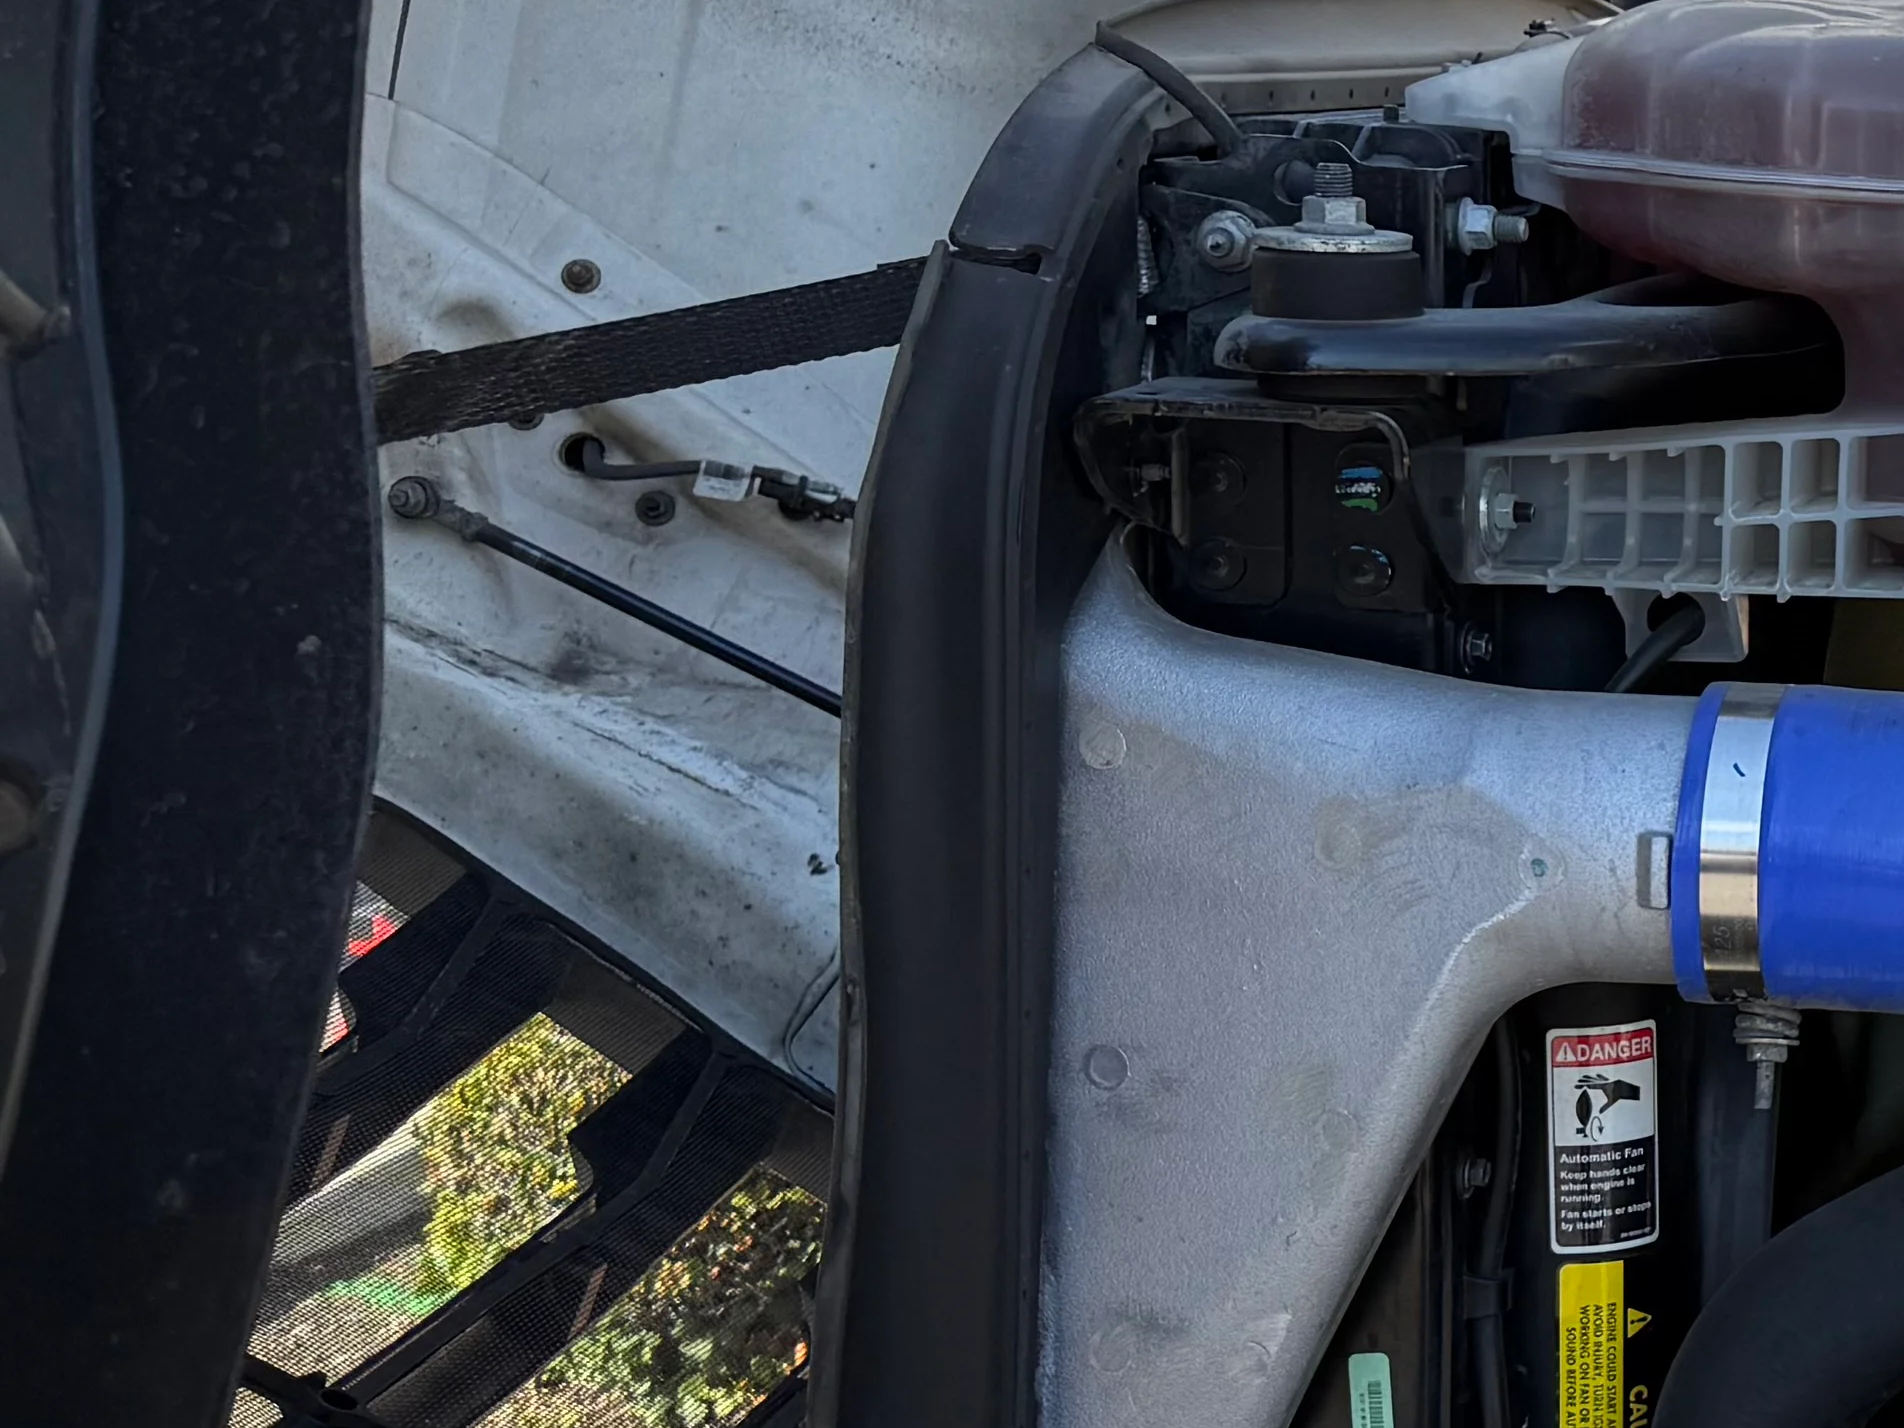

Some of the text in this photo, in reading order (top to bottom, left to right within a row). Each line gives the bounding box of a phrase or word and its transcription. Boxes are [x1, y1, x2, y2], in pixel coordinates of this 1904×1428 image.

[1577, 1036, 1651, 1062] DANGER
[1560, 1147, 1644, 1164] Automatic Fan
[1560, 1163, 1645, 1180] Keep hands clear
[1561, 1177, 1635, 1192] when engine is
[1561, 1192, 1604, 1203] running.
[1561, 1201, 1652, 1219] Fan starts or stops
[1561, 1222, 1573, 1231] by
[1579, 1306, 1590, 1358] WORKING
[1593, 1305, 1603, 1338] AVOID
[1606, 1303, 1616, 1342] ENGINE
[1566, 1327, 1576, 1365] SOUND
[1579, 1362, 1590, 1380] ON
[1607, 1346, 1616, 1382] COULD
[1566, 1369, 1576, 1407] BEFORE
[1579, 1384, 1590, 1405] FAN
[1593, 1385, 1603, 1411] TURN
[1606, 1385, 1616, 1415] START
[1579, 1408, 1590, 1423] OR
